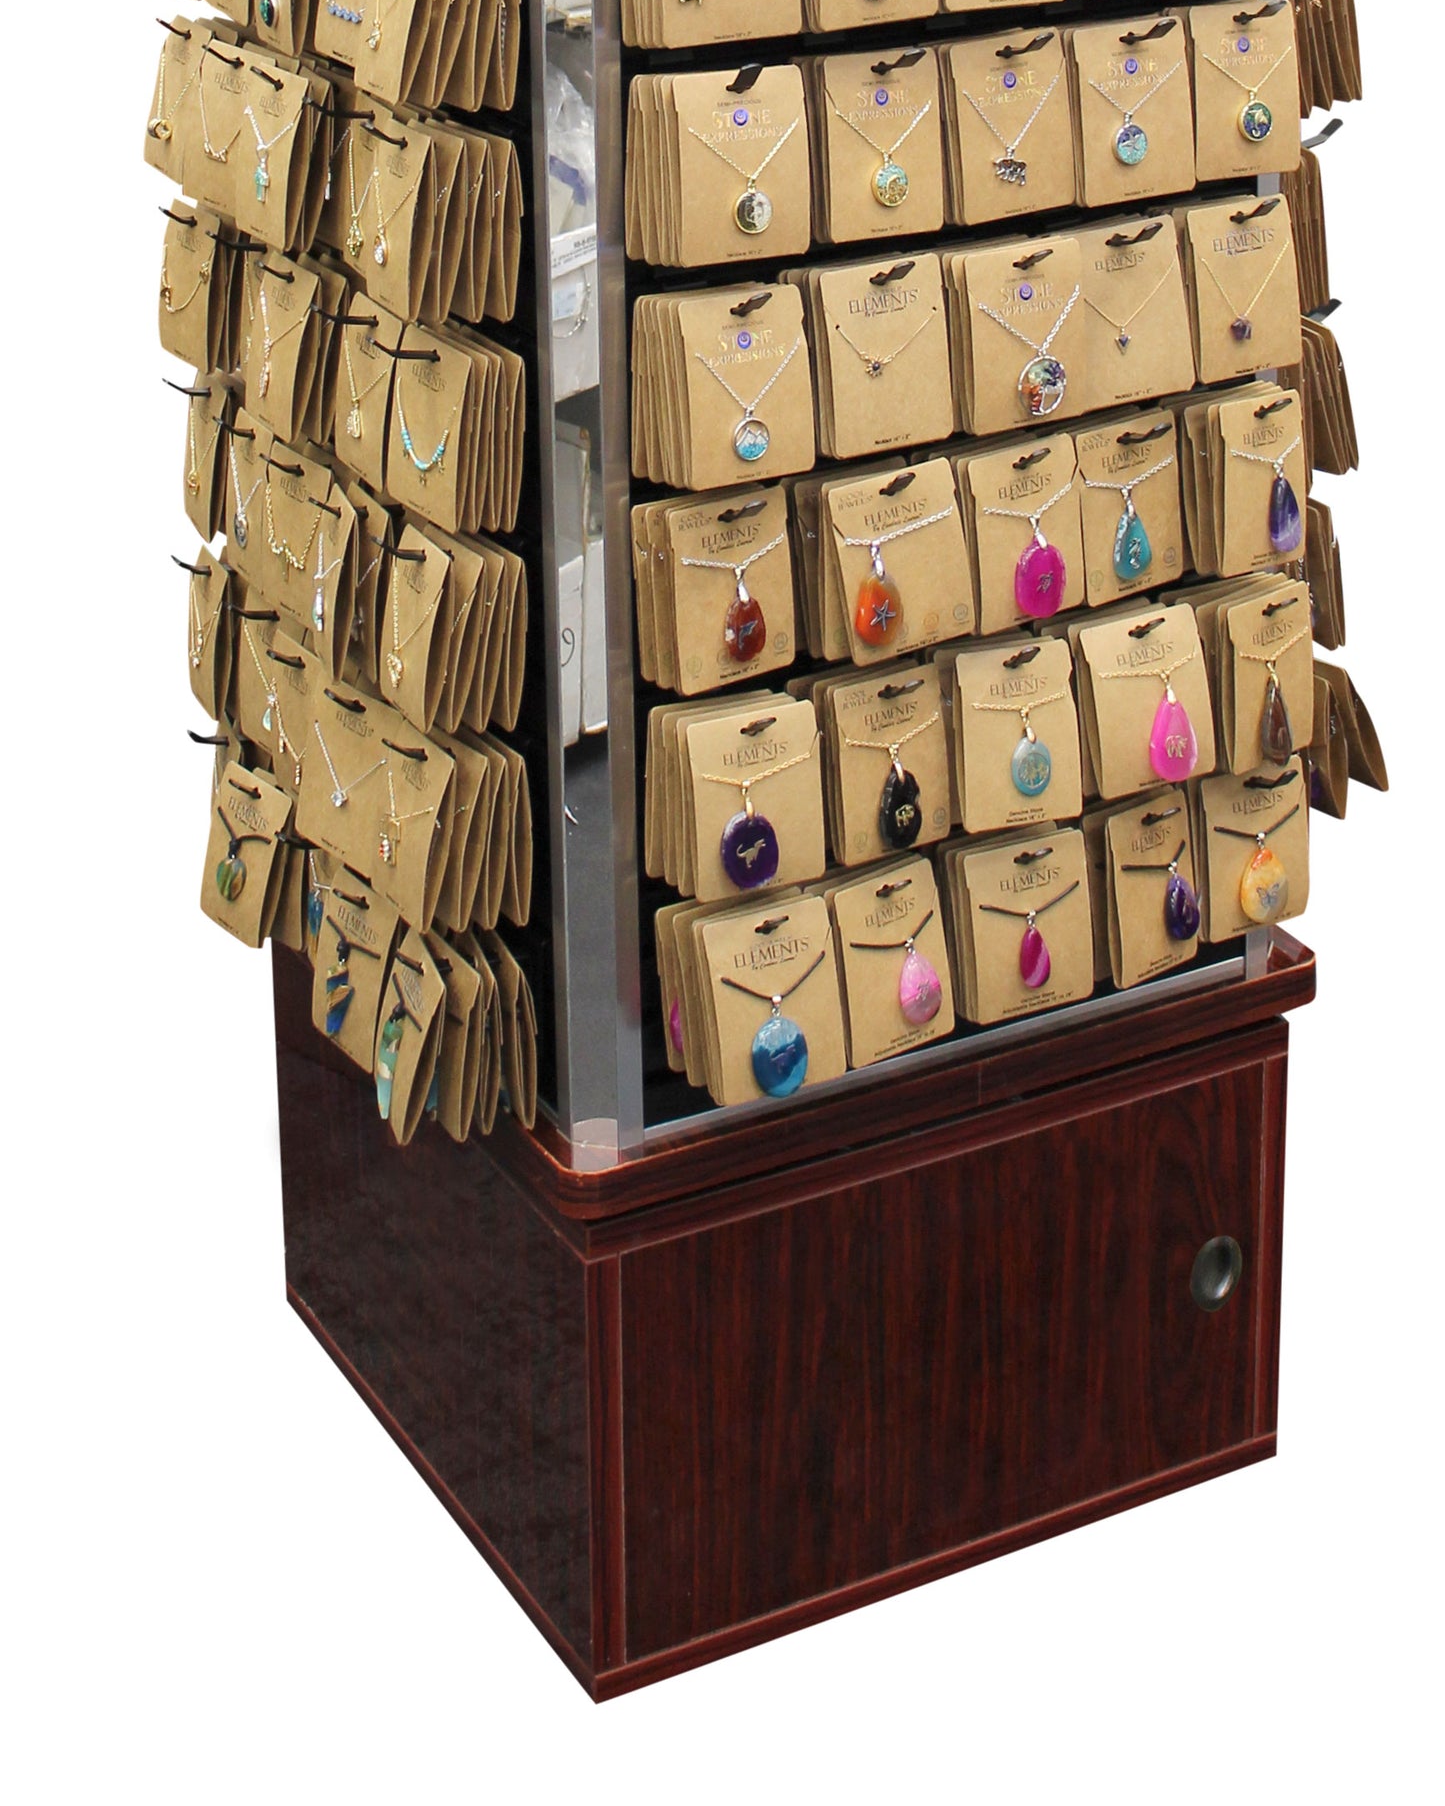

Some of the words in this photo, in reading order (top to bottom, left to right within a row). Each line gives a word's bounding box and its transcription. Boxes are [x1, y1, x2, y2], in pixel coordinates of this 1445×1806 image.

[1213, 228, 1275, 252] ELEMENTS
[849, 290, 920, 314] ELEMENTS
[1102, 445, 1152, 468] ELEMENTS
[998, 474, 1052, 498] ELEMENTS
[864, 499, 926, 525] ELEMENTS
[701, 526, 760, 547] ELEMENTS
[989, 677, 1048, 697] ELEMENTS
[864, 701, 918, 727] ELEMENTS
[723, 742, 787, 766] ELEMENTS
[1000, 868, 1061, 891] ELEMENTS
[734, 938, 809, 969] ELEMENTS
